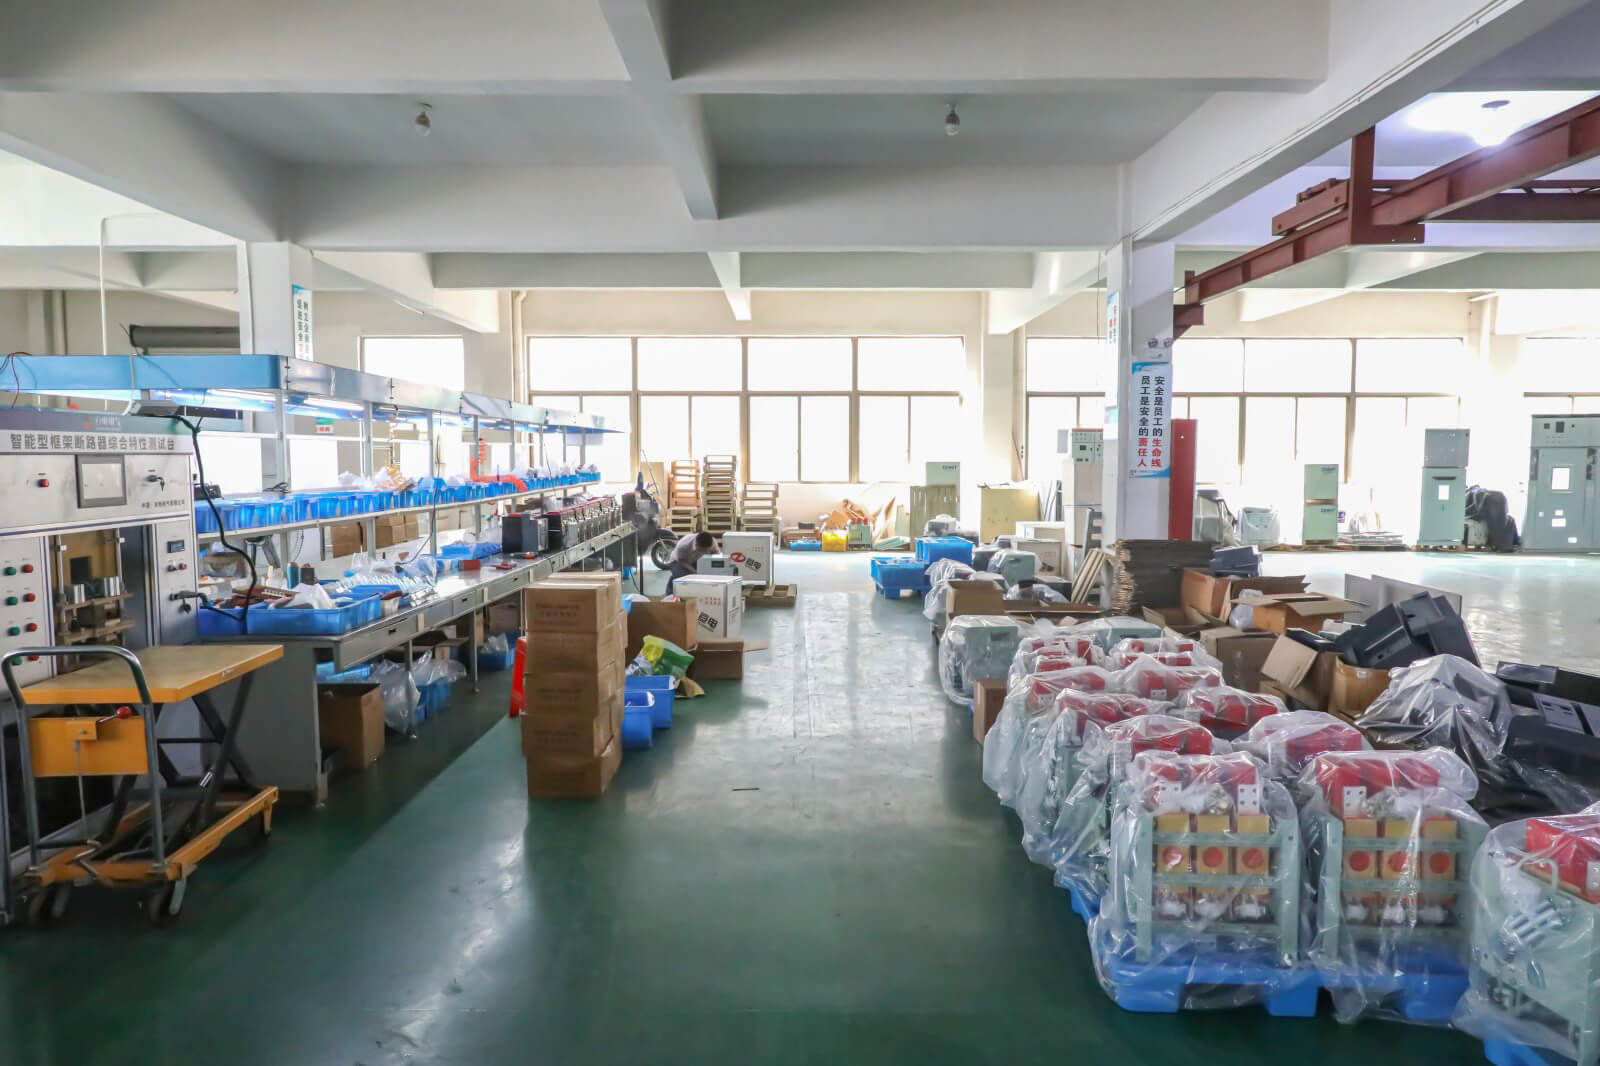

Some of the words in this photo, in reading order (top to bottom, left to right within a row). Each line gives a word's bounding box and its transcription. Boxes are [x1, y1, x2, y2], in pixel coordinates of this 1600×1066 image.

[10, 433, 175, 450] 智能型框架断路器综合特性测试台
[1136, 375, 1150, 467] 员工是安全的责任人
[1151, 375, 1165, 467] 安全是员工的生命线
